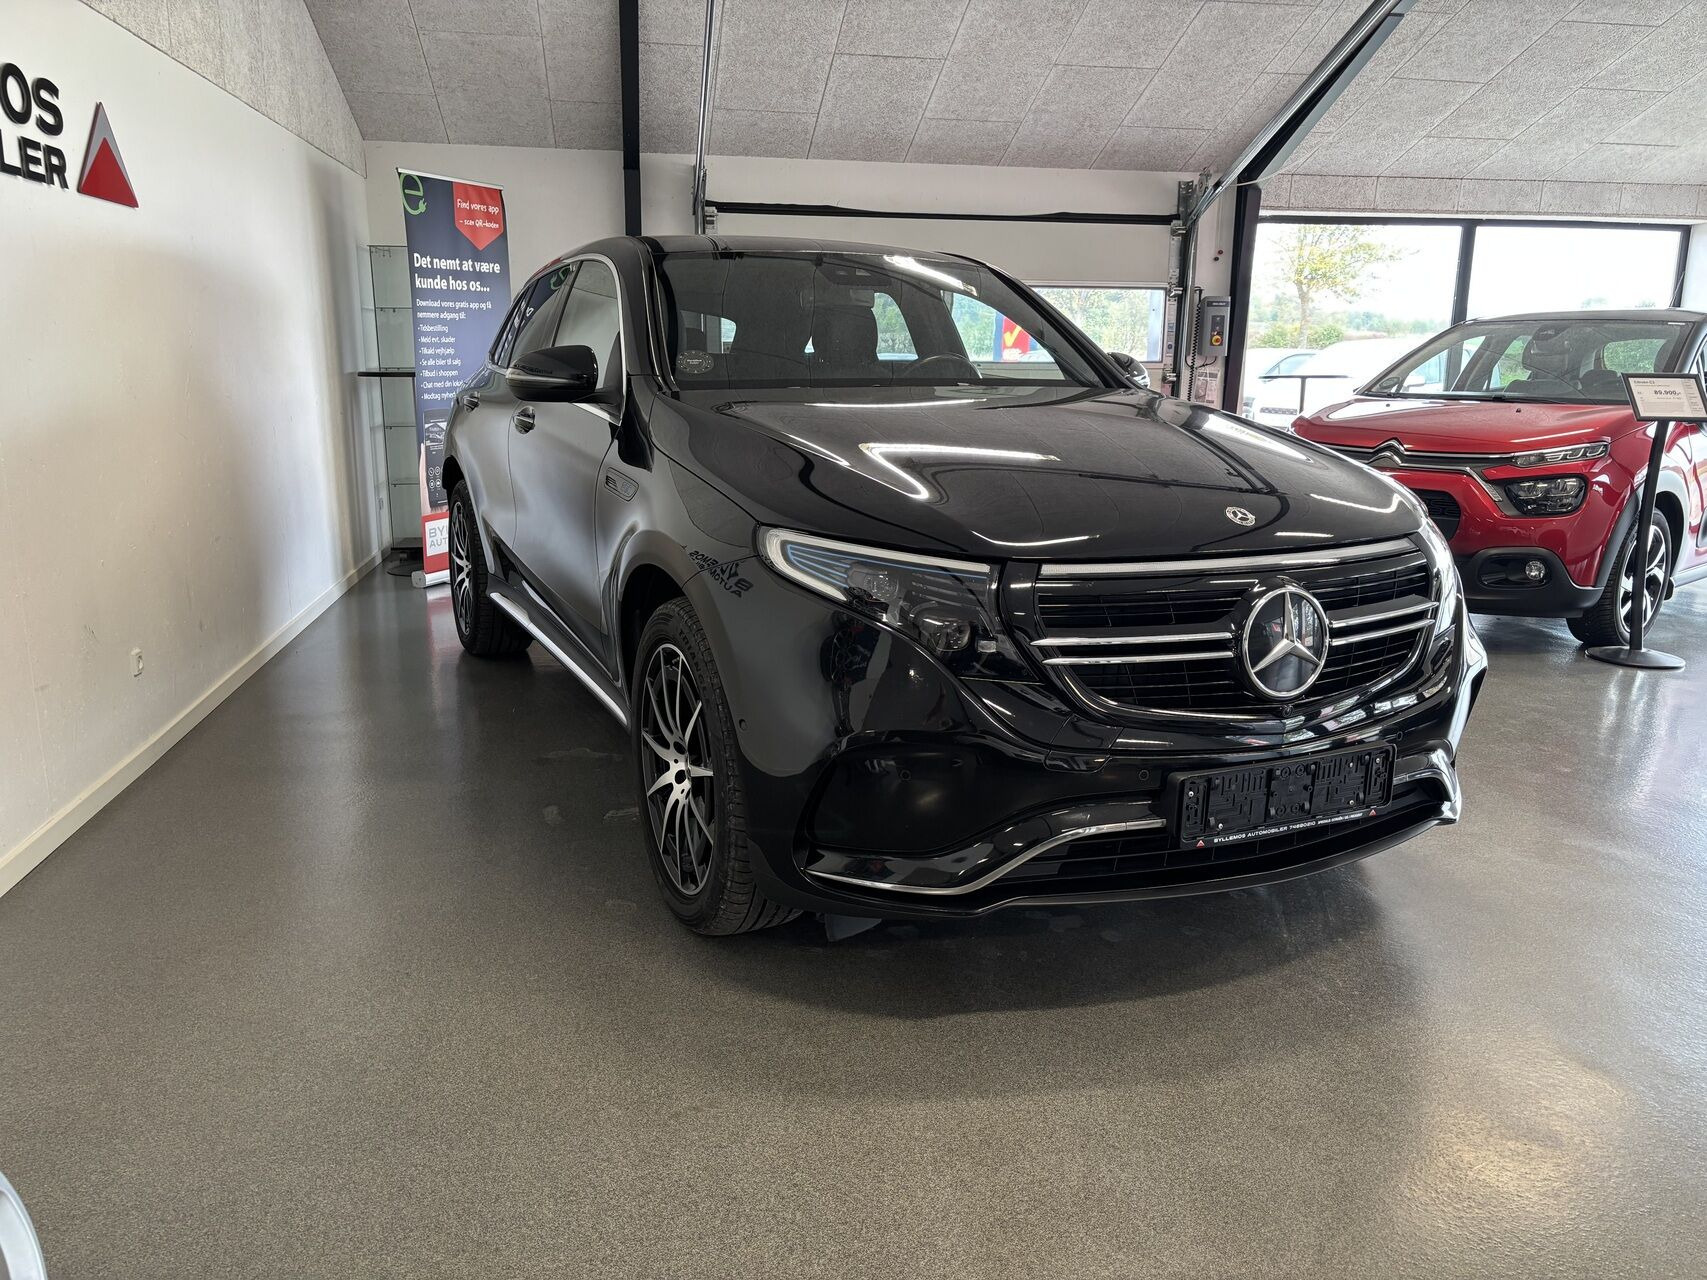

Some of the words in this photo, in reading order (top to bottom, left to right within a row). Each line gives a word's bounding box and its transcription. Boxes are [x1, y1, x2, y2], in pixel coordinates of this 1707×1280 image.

[457, 198, 470, 210] Find
[471, 203, 487, 212] vores
[488, 205, 500, 215] app
[414, 252, 431, 268] Det
[433, 258, 461, 271] nemt
[462, 259, 473, 271] at
[474, 261, 501, 274] være
[415, 273, 448, 290] kunde
[449, 276, 467, 291] hos
[470, 281, 490, 292] os...
[416, 298, 440, 307] Download
[455, 301, 469, 310] gratis
[470, 302, 480, 310] app
[480, 302, 486, 310] og
[486, 301, 492, 309] få
[440, 311, 459, 320] adgang
[420, 324, 448, 333] Tidsbestilling
[421, 358, 427, 366] Se
[452, 358, 461, 366] salg
[438, 370, 459, 378] shoppen
[423, 392, 440, 400] Modtag
[1213, 833, 1246, 843] BYLLEMOS
[1247, 826, 1288, 838] AUTOMOBILER
